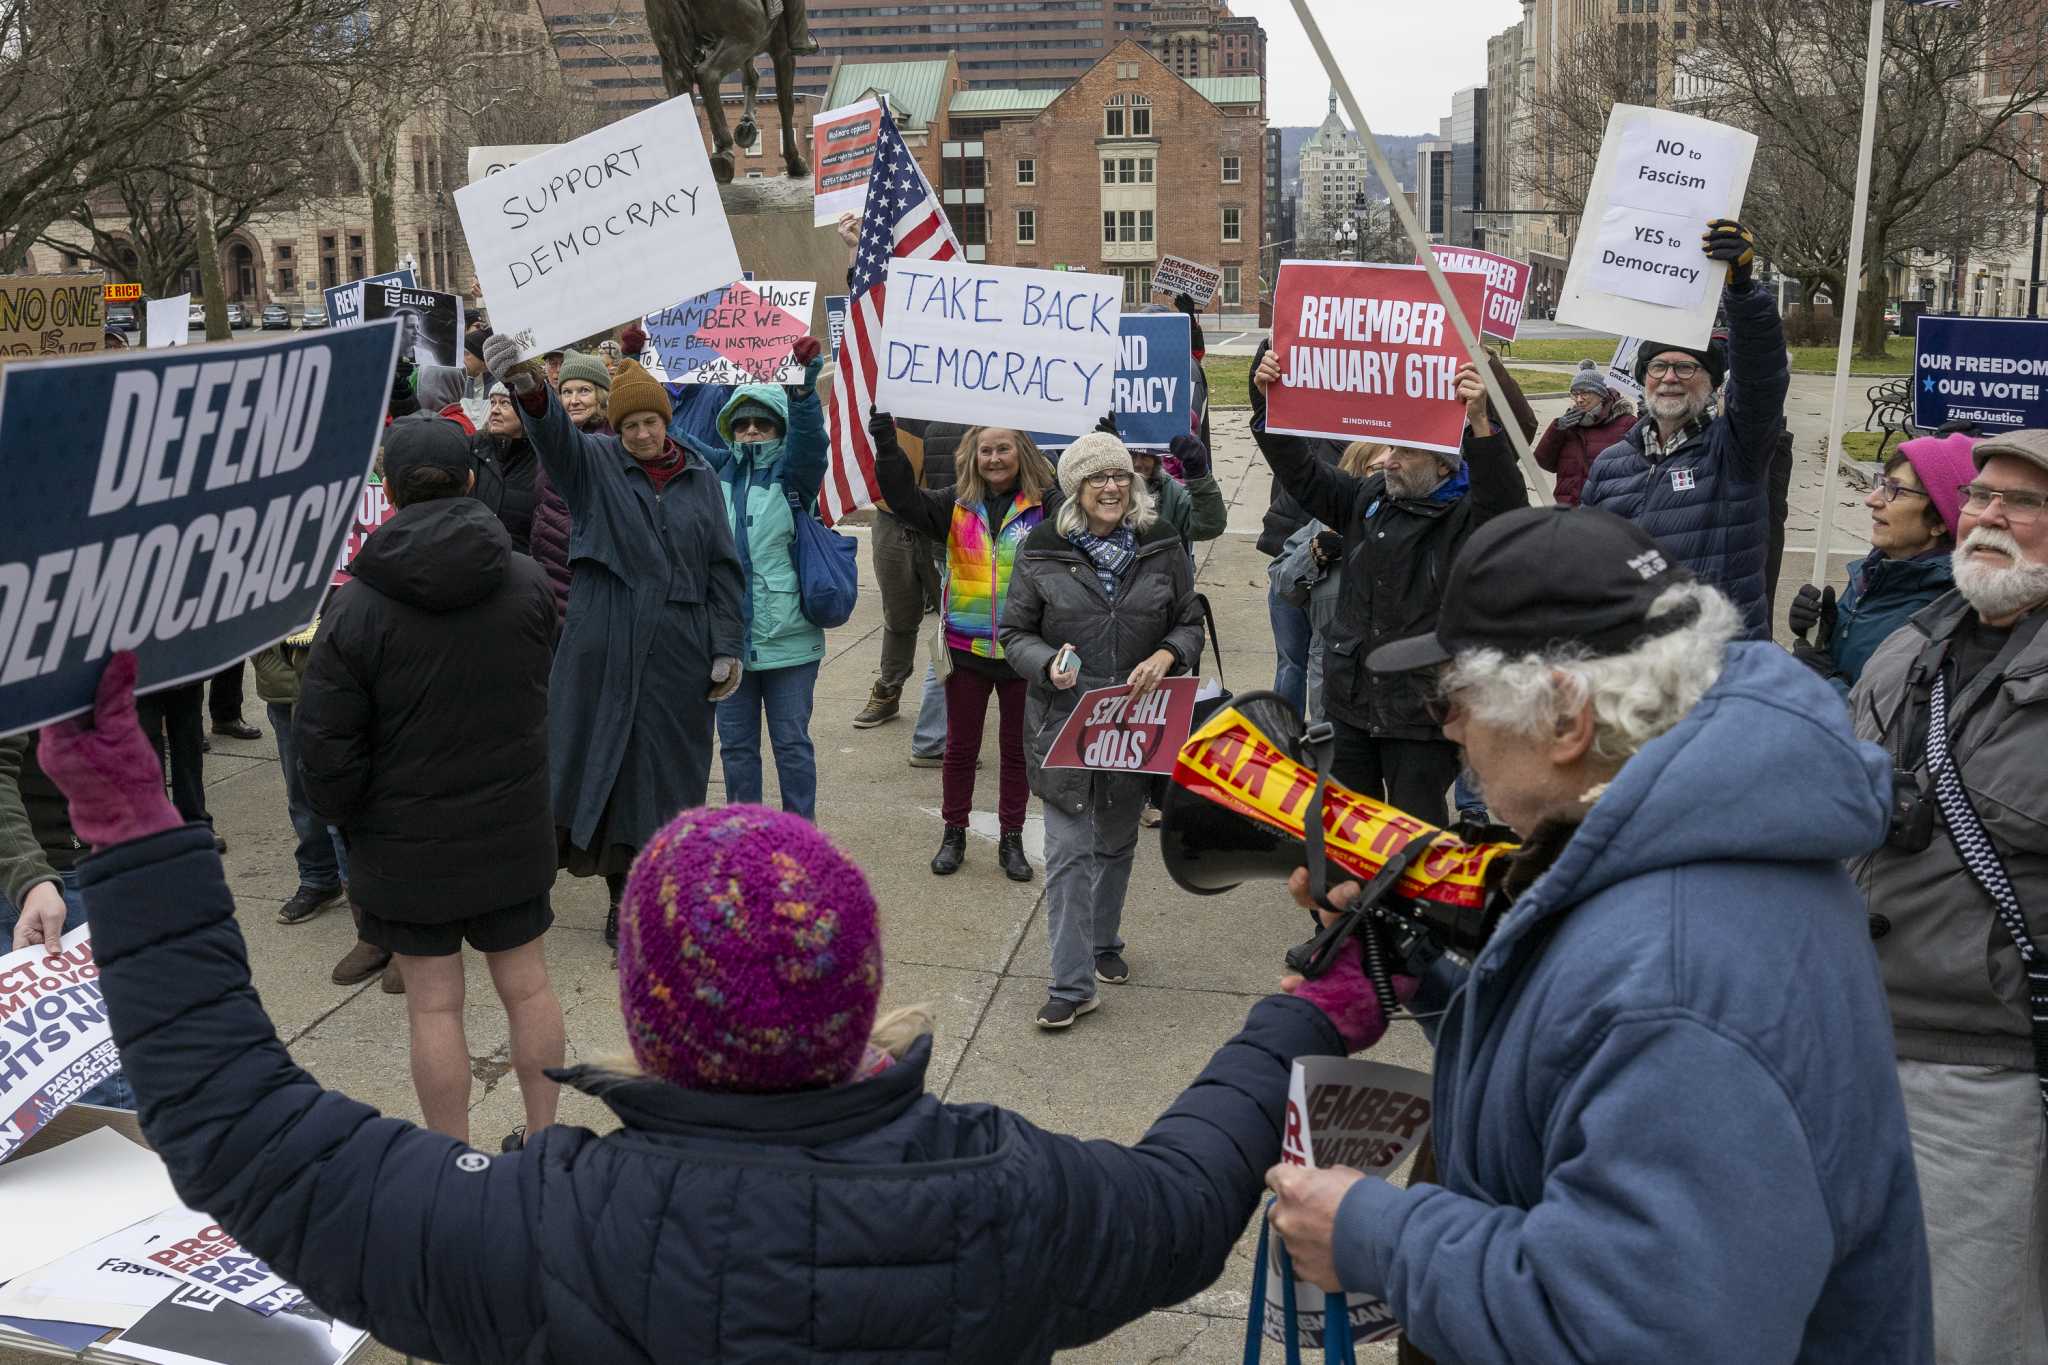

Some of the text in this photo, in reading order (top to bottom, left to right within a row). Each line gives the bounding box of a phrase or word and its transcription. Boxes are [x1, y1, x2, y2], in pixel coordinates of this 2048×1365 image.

[1655, 138, 1702, 161] NO to
[502, 144, 643, 230] SUPPORT
[1638, 165, 1706, 190] Fascism
[507, 185, 699, 289] DEMOCRACY
[1634, 226, 1681, 248] YES to
[1163, 258, 1220, 281] REMEMBER
[1601, 249, 1700, 284] Democracy
[114, 284, 140, 297] RICH
[714, 287, 753, 306] THE
[759, 285, 810, 307] HOUSE
[1157, 271, 1214, 295] PROTECT OUR
[0, 285, 101, 333] NO ONE
[896, 271, 1115, 335] TAKE BACK
[1489, 293, 1521, 327] 6TH
[646, 308, 782, 330] CHAMBER WE
[1298, 295, 1446, 347] REMEMBER
[40, 328, 64, 350] IS
[643, 333, 799, 350] HAVE BEEN INSTRUCTED
[656, 355, 687, 371] LIE
[688, 357, 729, 372] DOWN
[747, 356, 777, 371] PUT
[887, 340, 1104, 406] DEMOCRACY
[1281, 345, 1458, 401] JANUARY 6TH
[1919, 353, 1952, 371] OUR
[696, 370, 729, 385] GAS
[1938, 379, 2040, 401] OUR VOTE!
[1349, 418, 1393, 428] INDIVISIBLE
[1947, 408, 2024, 425] #Jan6Justice
[88, 344, 333, 517] DEFEND
[0, 475, 362, 685] DEMOCRACY
[1084, 688, 1172, 728] THE LIES
[1084, 729, 1147, 770] STOP
[42, 939, 94, 973] OU
[22, 976, 62, 999] TO
[4, 979, 105, 1038] VOTI
[44, 1070, 73, 1097] DAY
[71, 1054, 94, 1073] OF
[53, 1076, 85, 1105] AND
